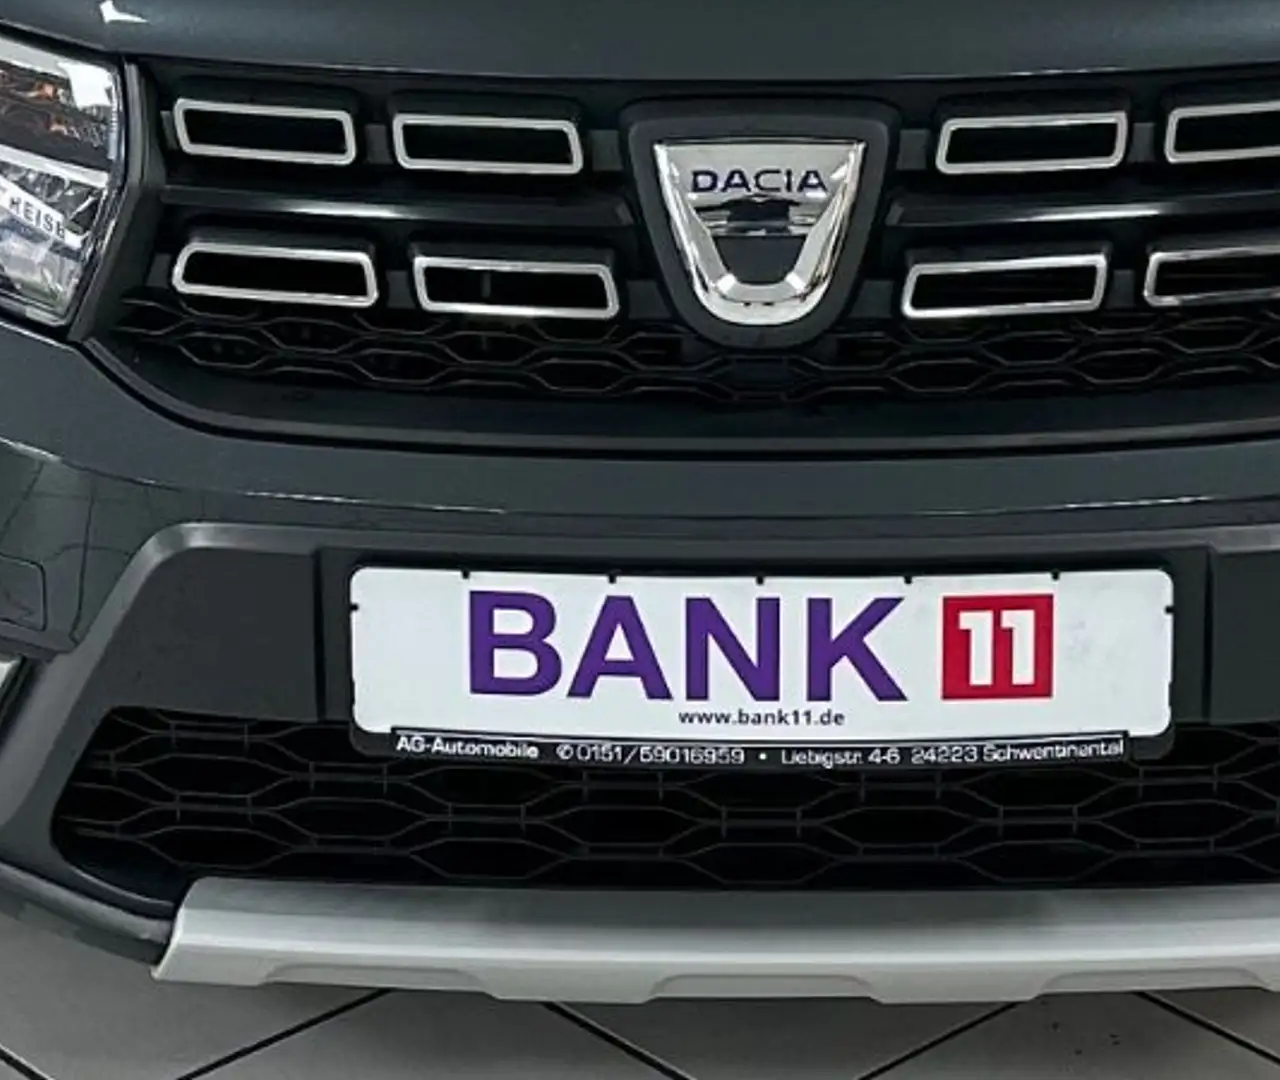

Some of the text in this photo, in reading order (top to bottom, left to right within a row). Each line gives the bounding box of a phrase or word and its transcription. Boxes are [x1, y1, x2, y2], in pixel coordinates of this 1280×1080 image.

[690, 169, 829, 194] DACIA
[469, 590, 1039, 702] BANK 11
[678, 709, 846, 727] www.bank11.de
[395, 735, 540, 760] AG-Automobile
[868, 747, 901, 765] 4-6
[911, 746, 978, 764] 24223
